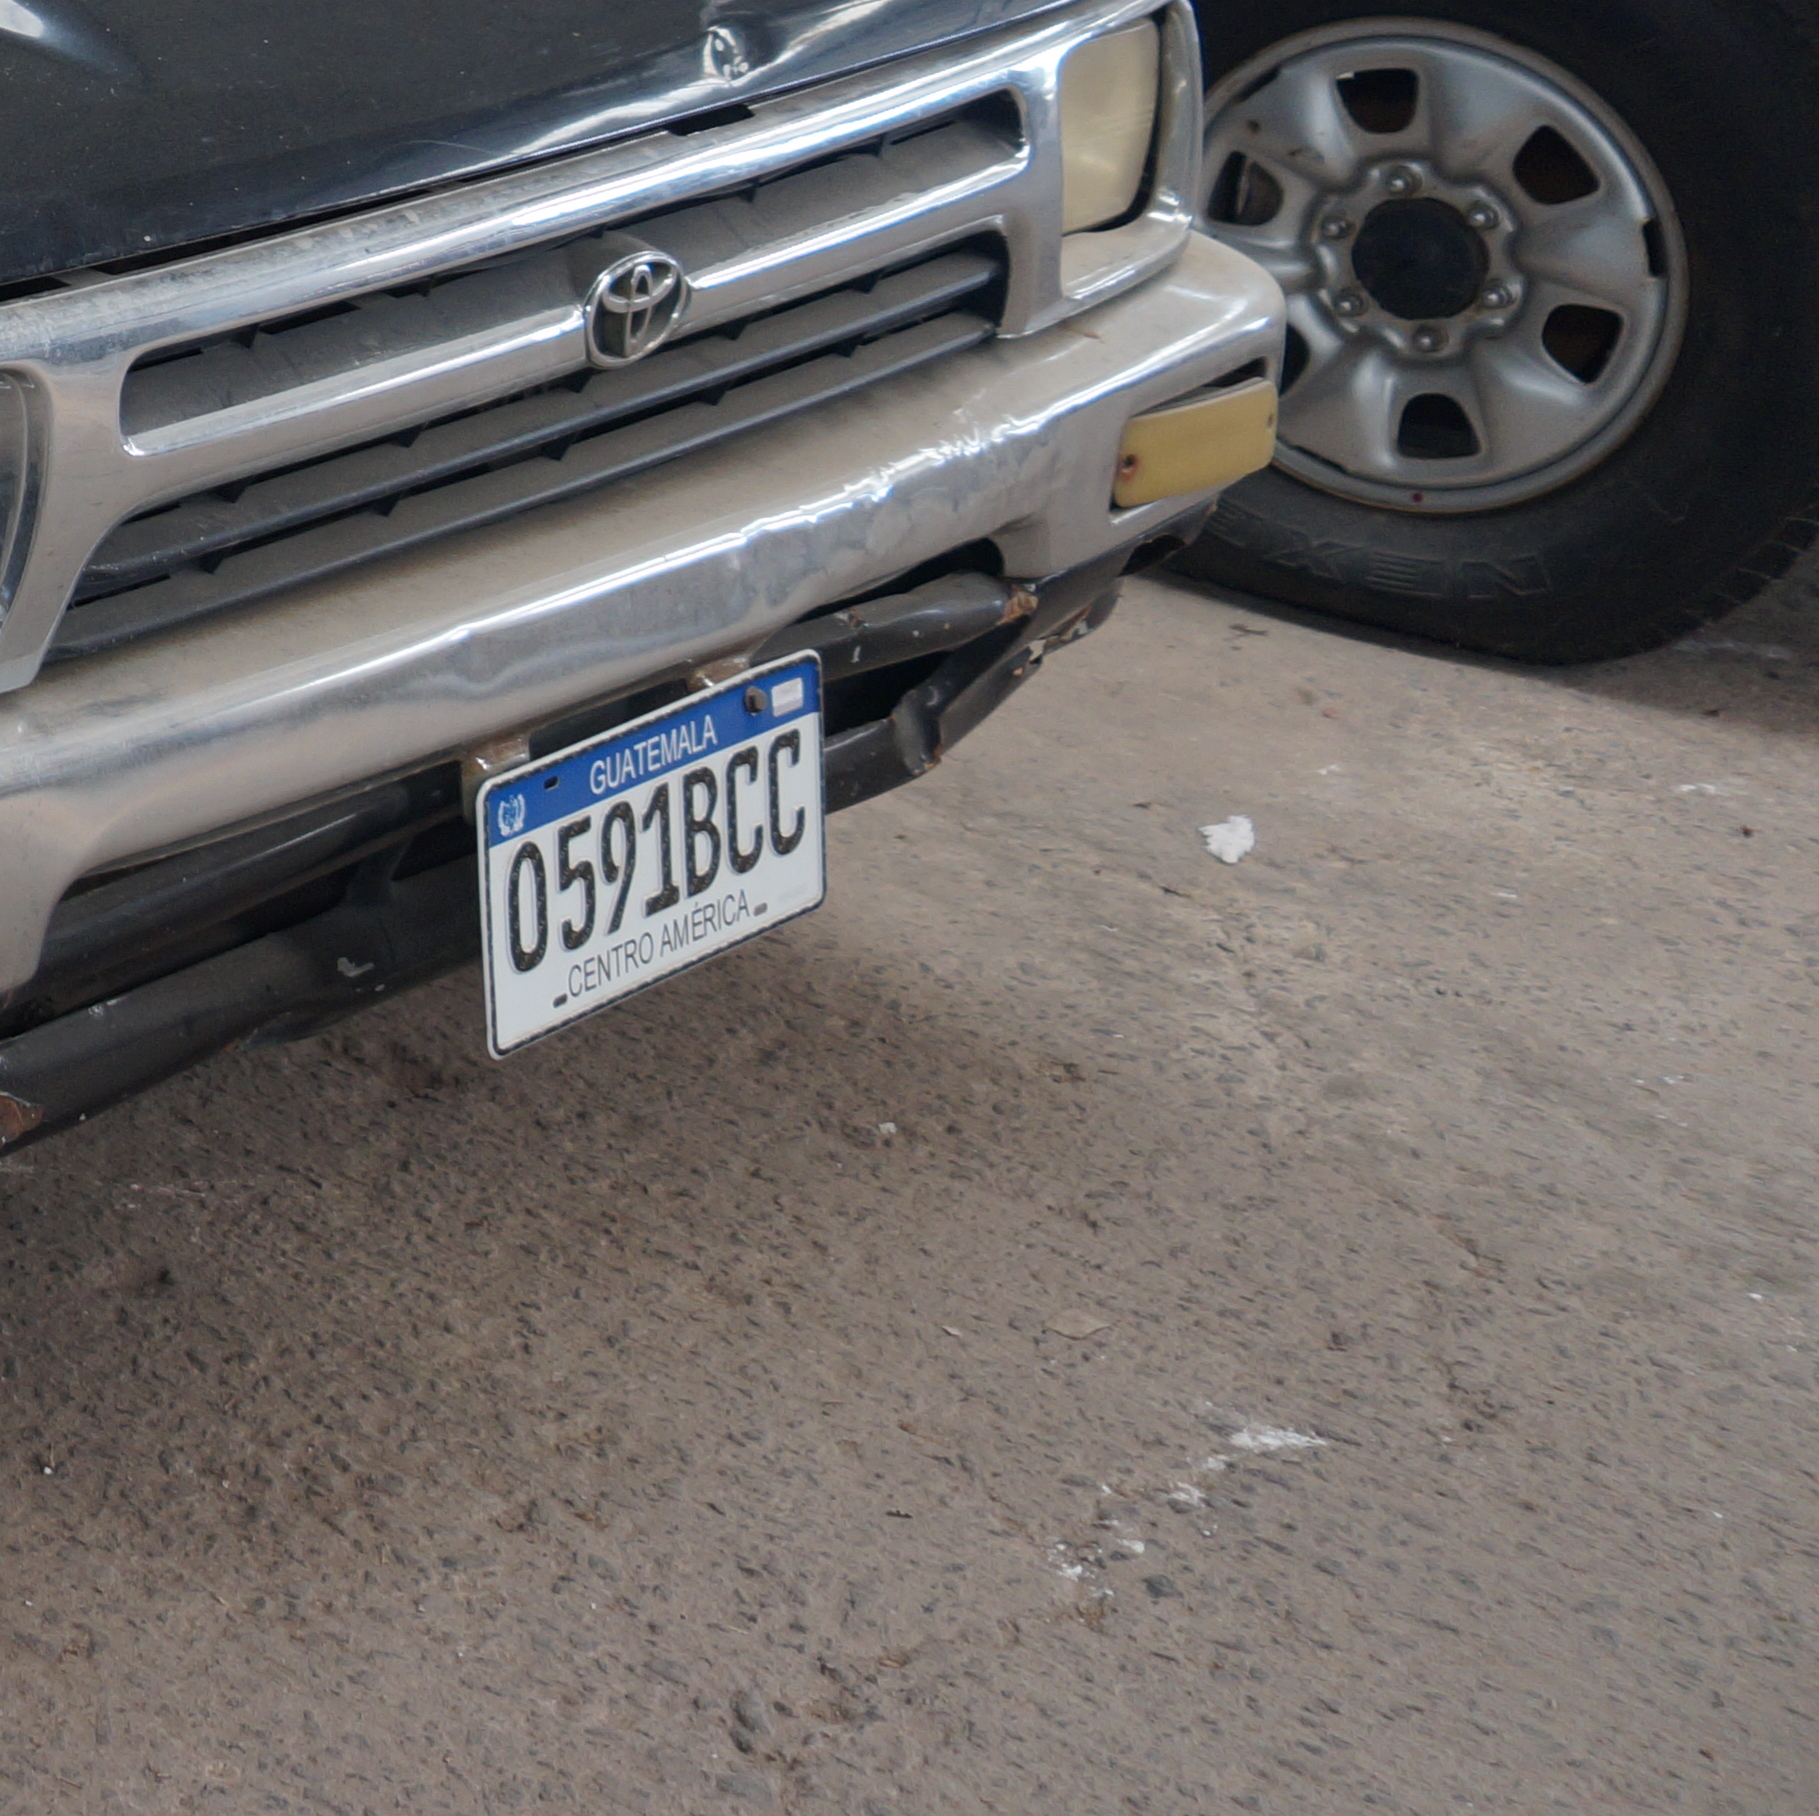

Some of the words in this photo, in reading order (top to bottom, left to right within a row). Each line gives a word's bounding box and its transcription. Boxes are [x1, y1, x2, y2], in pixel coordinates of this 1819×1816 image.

[1201, 496, 1551, 599] NEXE
[589, 714, 718, 795] GUATEMALA
[508, 727, 806, 973] 0591BCC
[568, 932, 654, 999] CENTRO
[660, 889, 751, 957] AMÉRICA
